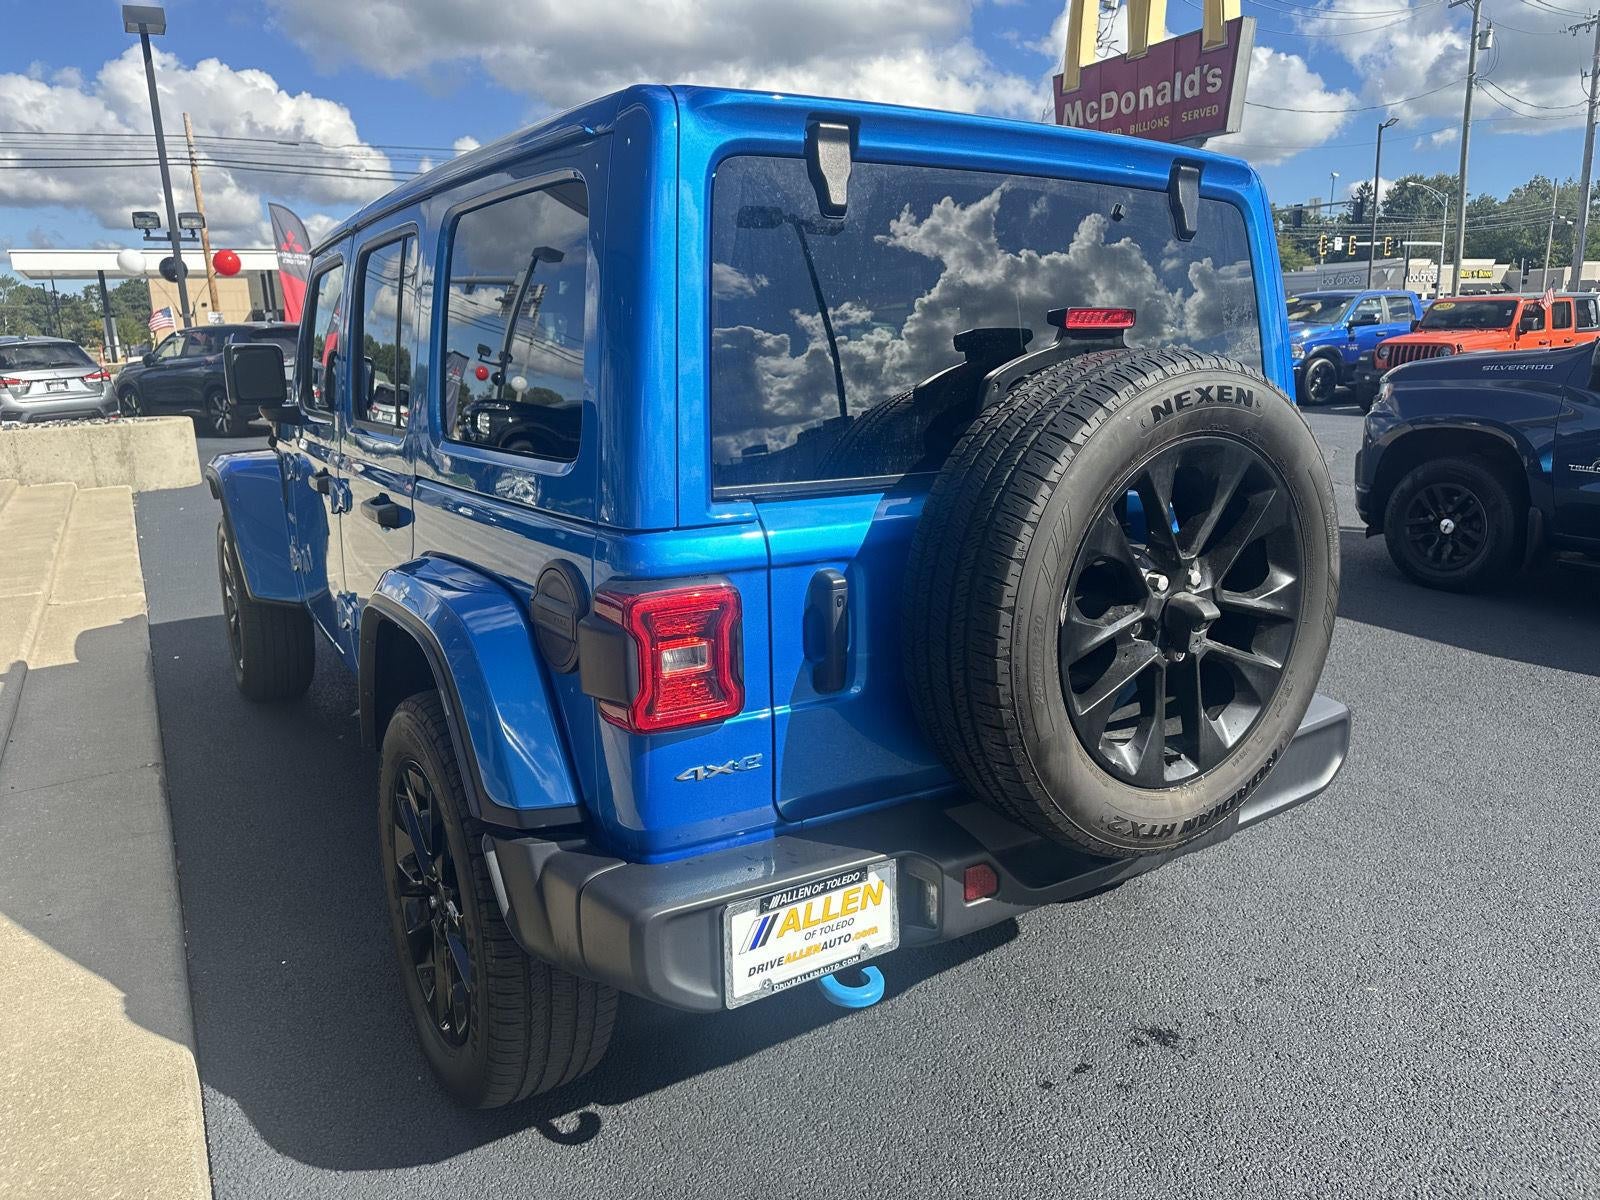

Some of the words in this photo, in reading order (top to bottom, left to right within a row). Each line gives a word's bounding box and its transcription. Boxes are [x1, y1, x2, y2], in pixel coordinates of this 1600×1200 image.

[1062, 64, 1223, 127] McDonald's
[1129, 116, 1170, 134] BILLIONS
[1181, 104, 1219, 122] SERVED
[1150, 385, 1254, 424] NEXEN
[1107, 815, 1178, 839] HTX2
[779, 885, 812, 904] ALLEN
[812, 881, 825, 894] OF
[826, 871, 860, 889] TOLEDO
[776, 880, 885, 939] ALLEN
[804, 930, 818, 941] OF
[819, 917, 855, 936] TOLEDO
[748, 926, 878, 978] DRIVEALLENAUTO.com
[773, 955, 860, 992] DRIVEALLENAUTO.COM
